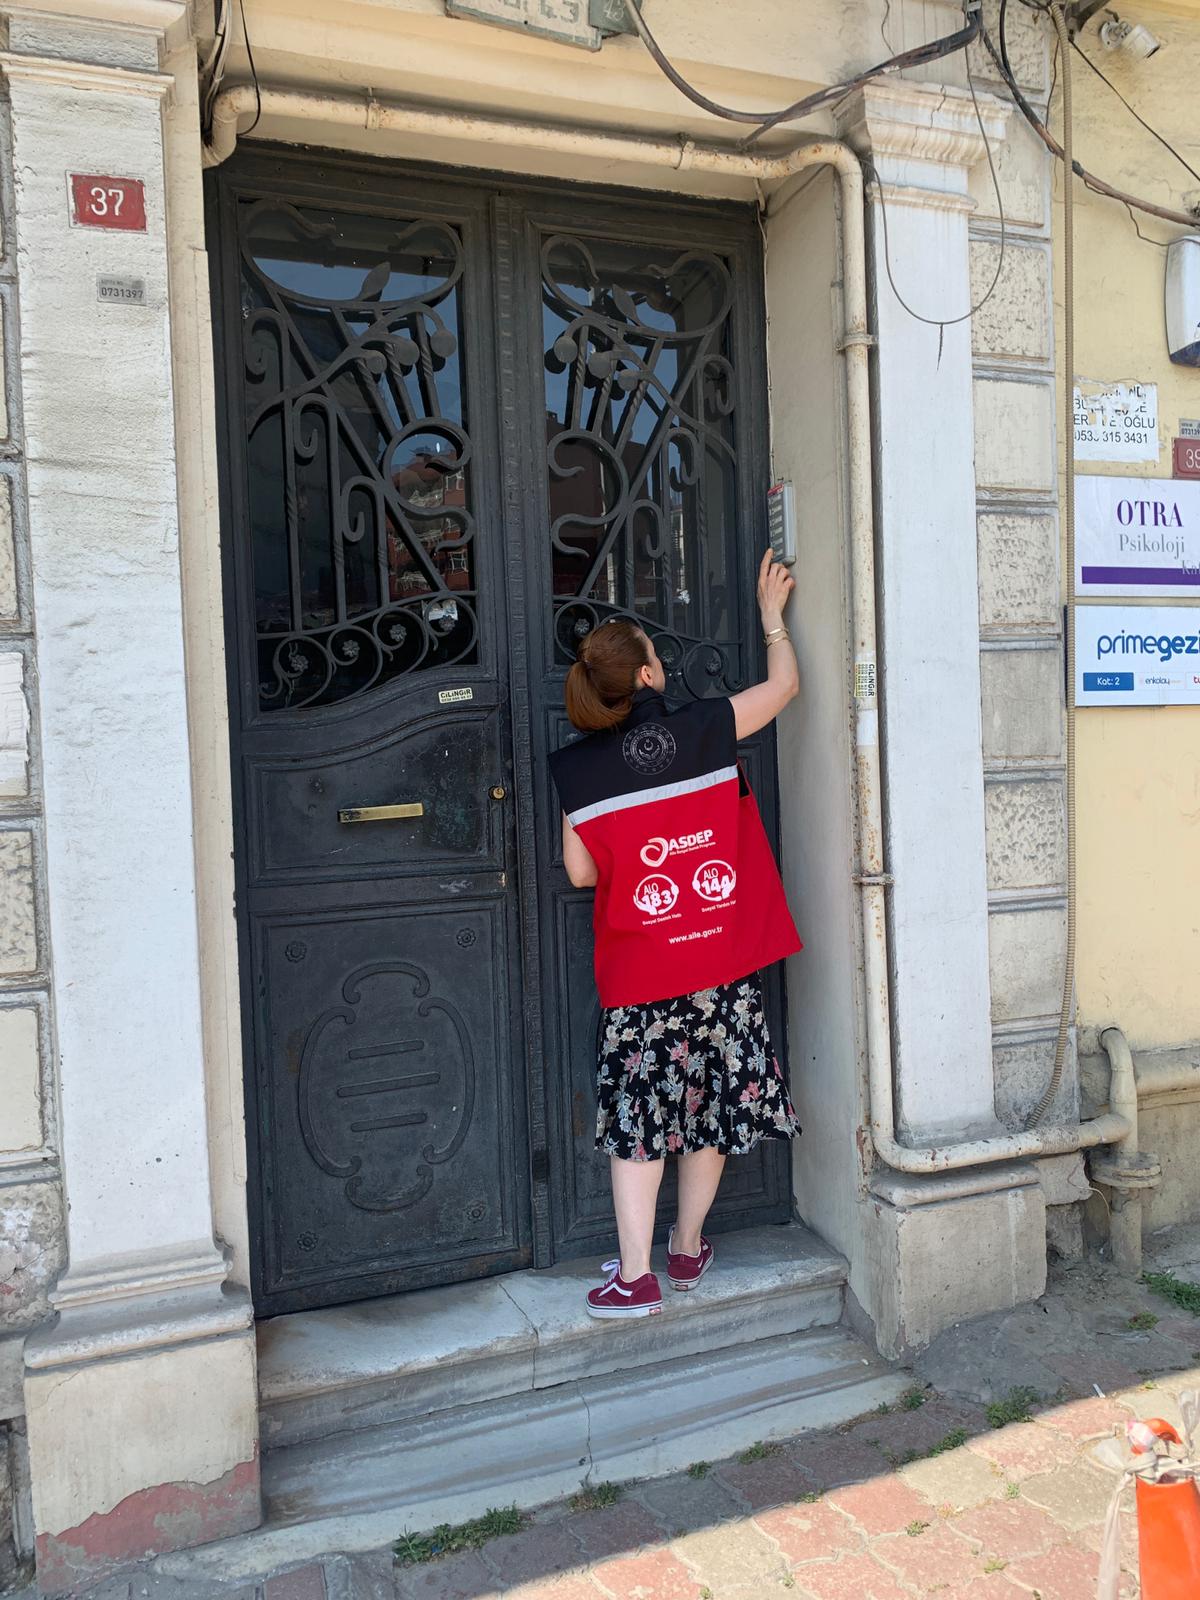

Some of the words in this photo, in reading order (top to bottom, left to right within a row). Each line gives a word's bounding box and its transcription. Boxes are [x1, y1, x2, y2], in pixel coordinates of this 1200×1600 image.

[90, 187, 124, 216] 37
[101, 287, 144, 298] 0731397
[1124, 432, 1148, 443] 3431
[1116, 499, 1184, 528] OTRA
[1119, 533, 1185, 560] Psikoloji
[1182, 560, 1200, 575] Ka
[1097, 629, 1200, 662] primegez
[1115, 677, 1120, 686] 2
[669, 829, 714, 852] ASDEP
[703, 868, 719, 881] ALO
[643, 882, 659, 896] ALO
[701, 875, 731, 895] 144
[641, 890, 672, 907] 183
[669, 926, 723, 944] www.aile.gov.tr
